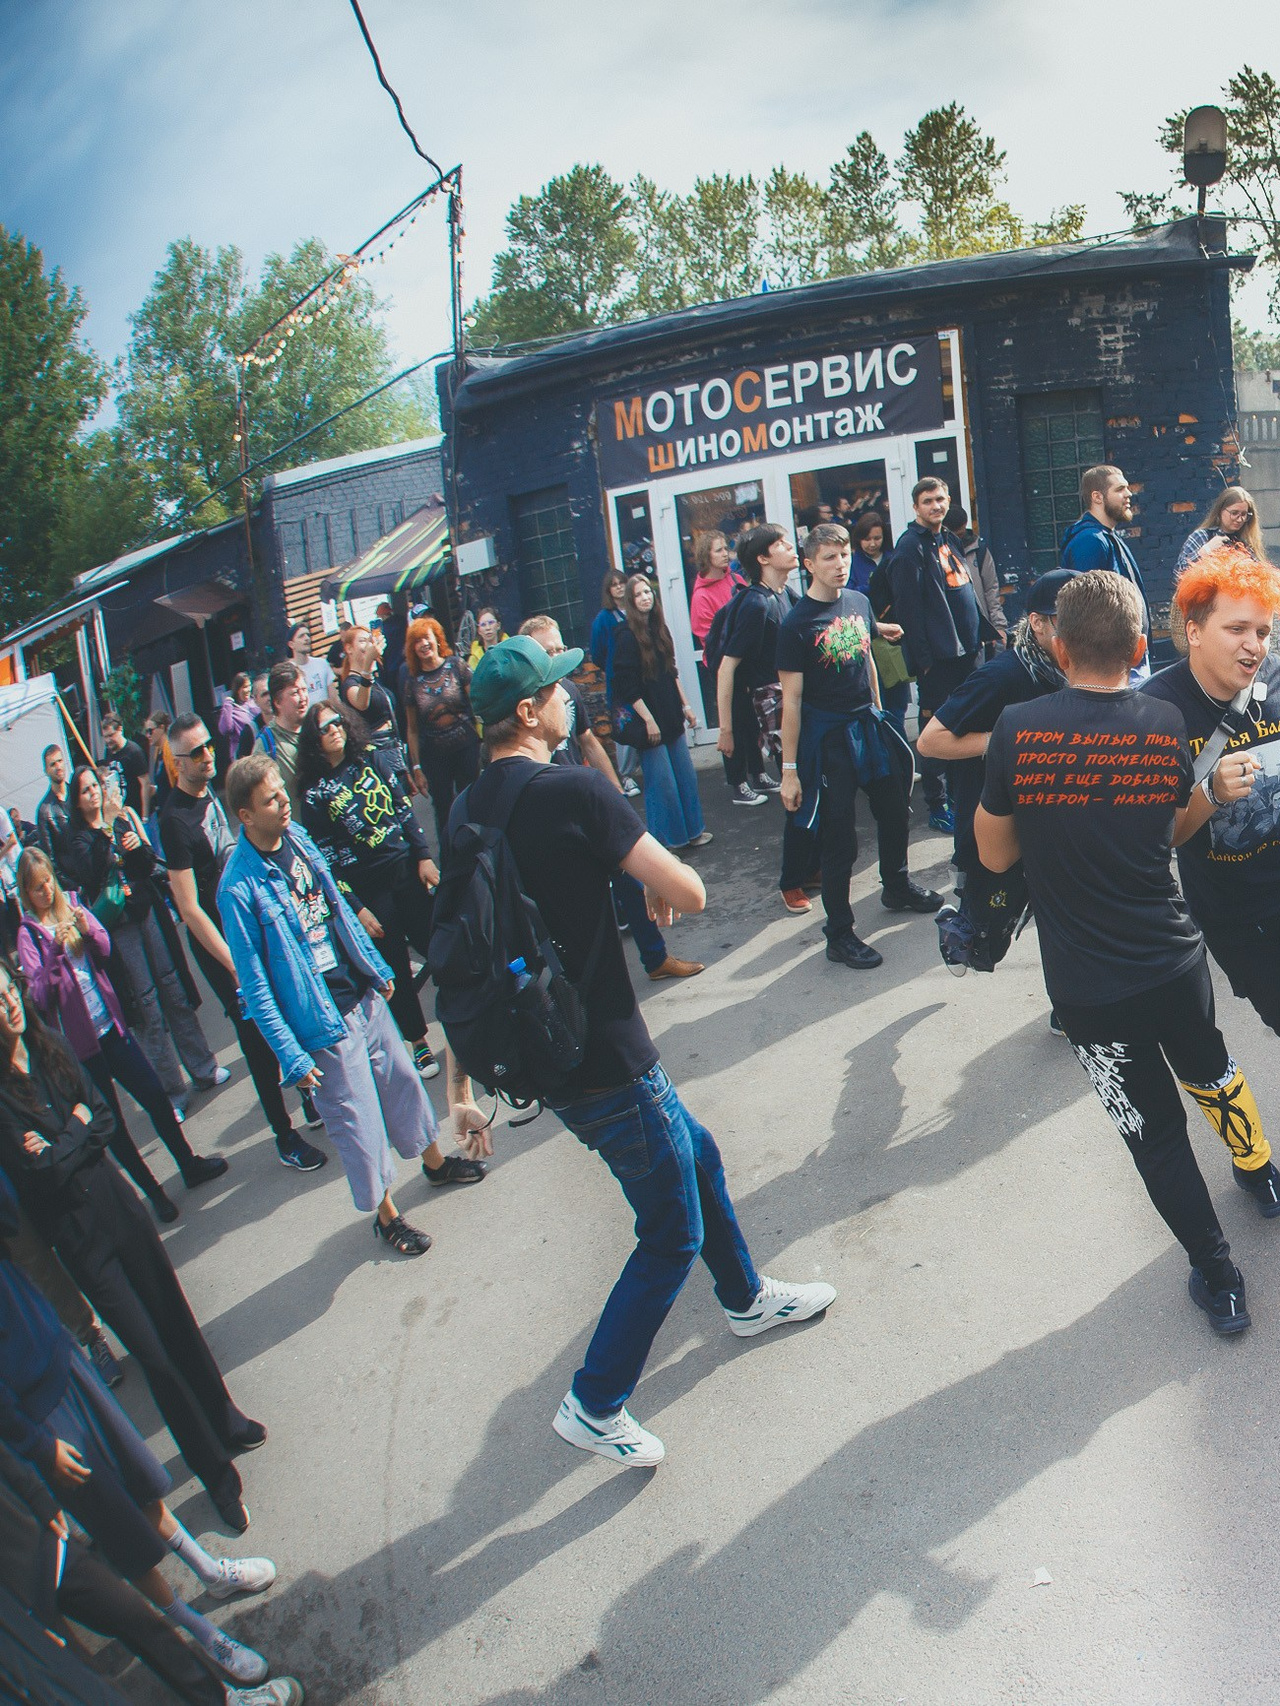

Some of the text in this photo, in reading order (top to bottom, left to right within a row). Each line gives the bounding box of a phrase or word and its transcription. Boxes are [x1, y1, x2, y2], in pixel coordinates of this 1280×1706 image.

[614, 342, 919, 441] МОТОСЕРВИС
[1014, 729, 1065, 746] УТРОМ
[1068, 732, 1138, 747] ВЫПЬЮ
[1016, 752, 1078, 767] ПРОСТО
[1012, 772, 1057, 787] ДНЕМ
[1063, 772, 1103, 788] ЕЩЕ
[1017, 791, 1091, 807] ВЕЧЕРОМ
